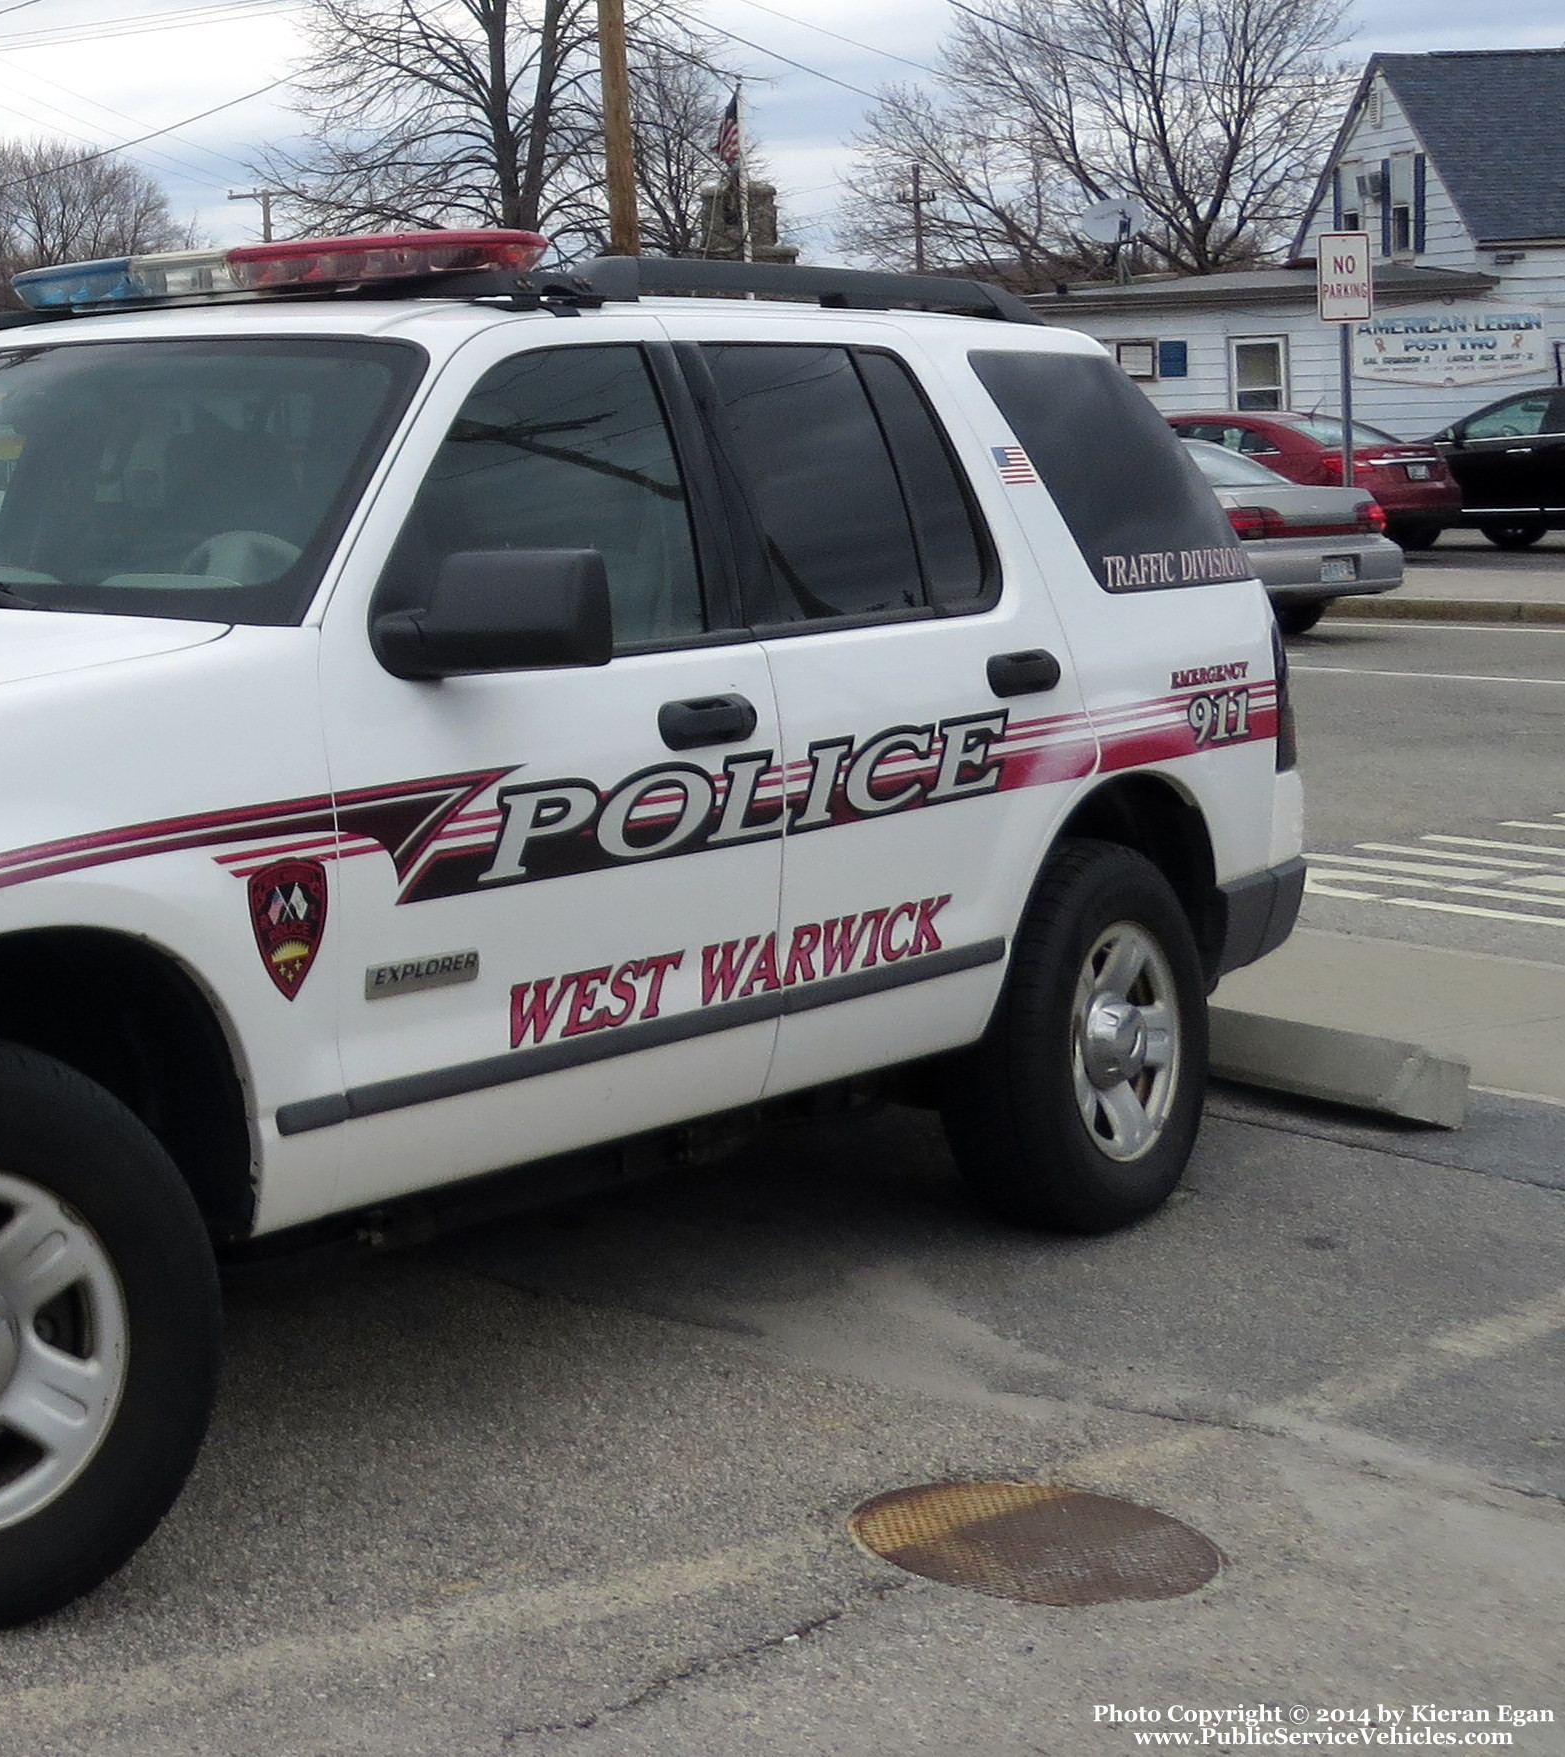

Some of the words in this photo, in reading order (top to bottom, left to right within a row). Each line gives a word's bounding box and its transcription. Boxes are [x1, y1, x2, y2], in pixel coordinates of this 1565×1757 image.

[1333, 255, 1356, 274] NO
[1322, 283, 1368, 299] PARKING
[1356, 315, 1466, 335] AMERICAN
[1475, 313, 1542, 331] LEGION
[1404, 337, 1448, 352] POST
[1460, 335, 1497, 350] TWO
[1103, 552, 1176, 587] TRAFFIC
[1180, 547, 1247, 580] DIVISION
[1171, 661, 1249, 689] EMERGENCY
[1187, 688, 1250, 745] 911
[476, 708, 1010, 882] POLICE
[375, 953, 478, 985] EXPLORER
[509, 950, 685, 1049] WEST
[700, 894, 952, 1006] WARWICK
